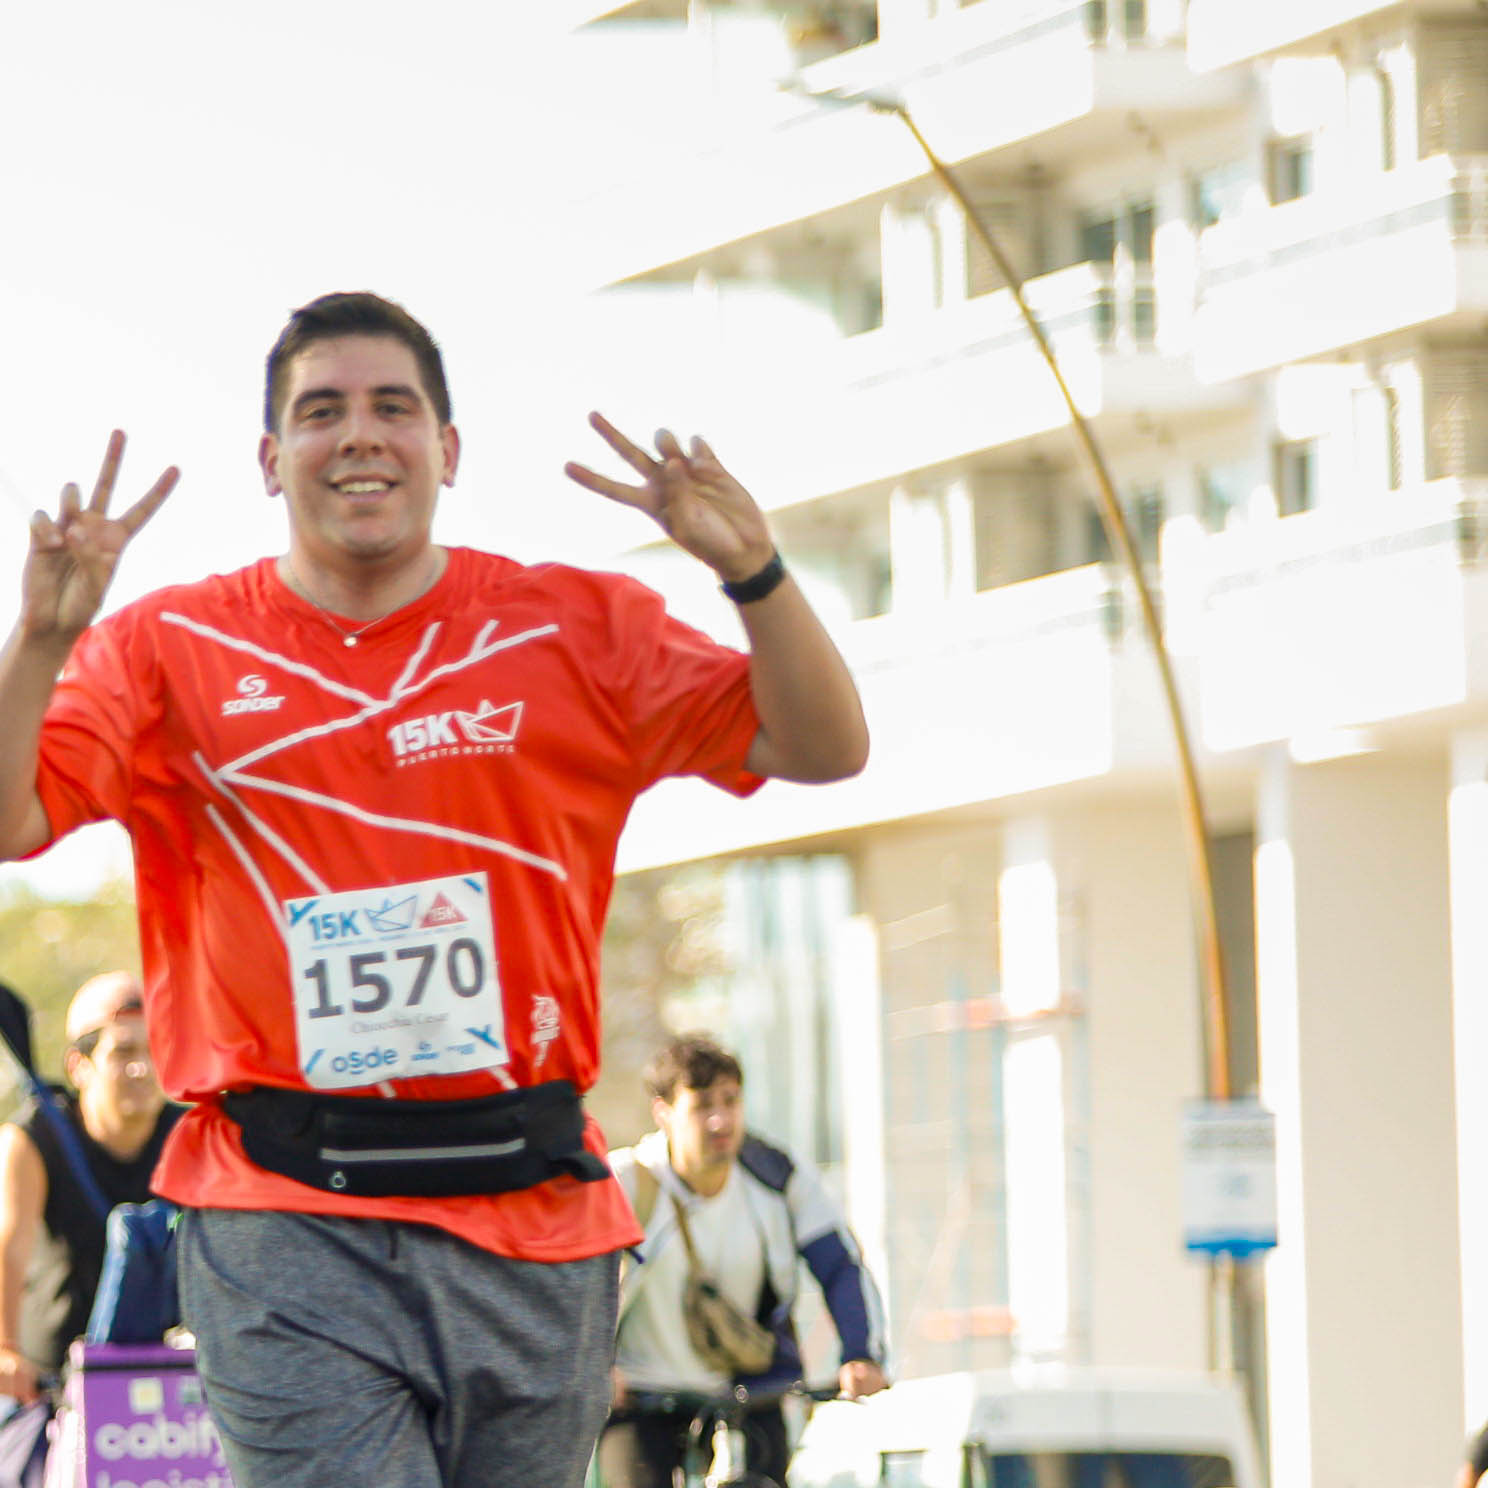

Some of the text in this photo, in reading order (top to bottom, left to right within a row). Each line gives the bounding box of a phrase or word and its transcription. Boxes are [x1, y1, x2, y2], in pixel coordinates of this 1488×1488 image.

[387, 710, 459, 756] 15K
[309, 909, 362, 941] 15K
[304, 937, 483, 1019] 1570
[331, 1046, 399, 1074] osde
